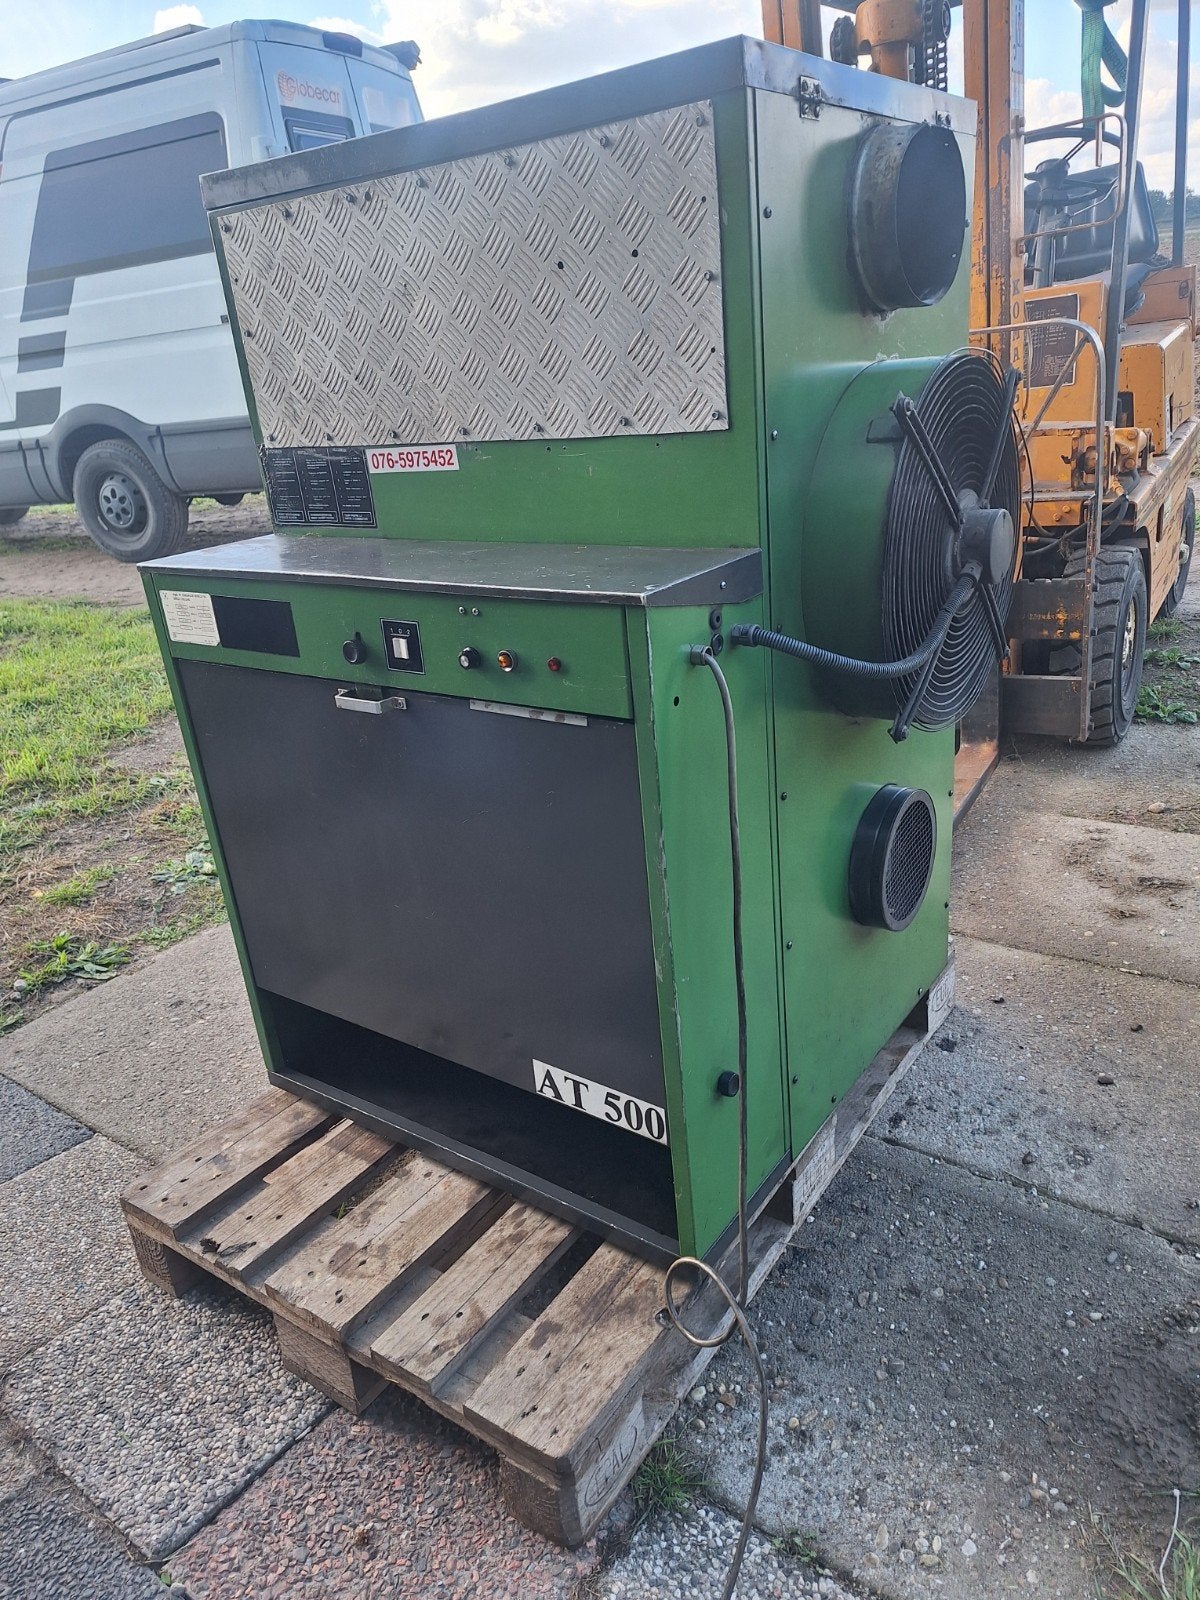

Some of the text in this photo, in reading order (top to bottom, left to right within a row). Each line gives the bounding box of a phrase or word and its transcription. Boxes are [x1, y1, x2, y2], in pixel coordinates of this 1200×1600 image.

[287, 76, 340, 103] Globecar
[371, 448, 455, 470] 076-5975452
[538, 1068, 665, 1140] AT 500
